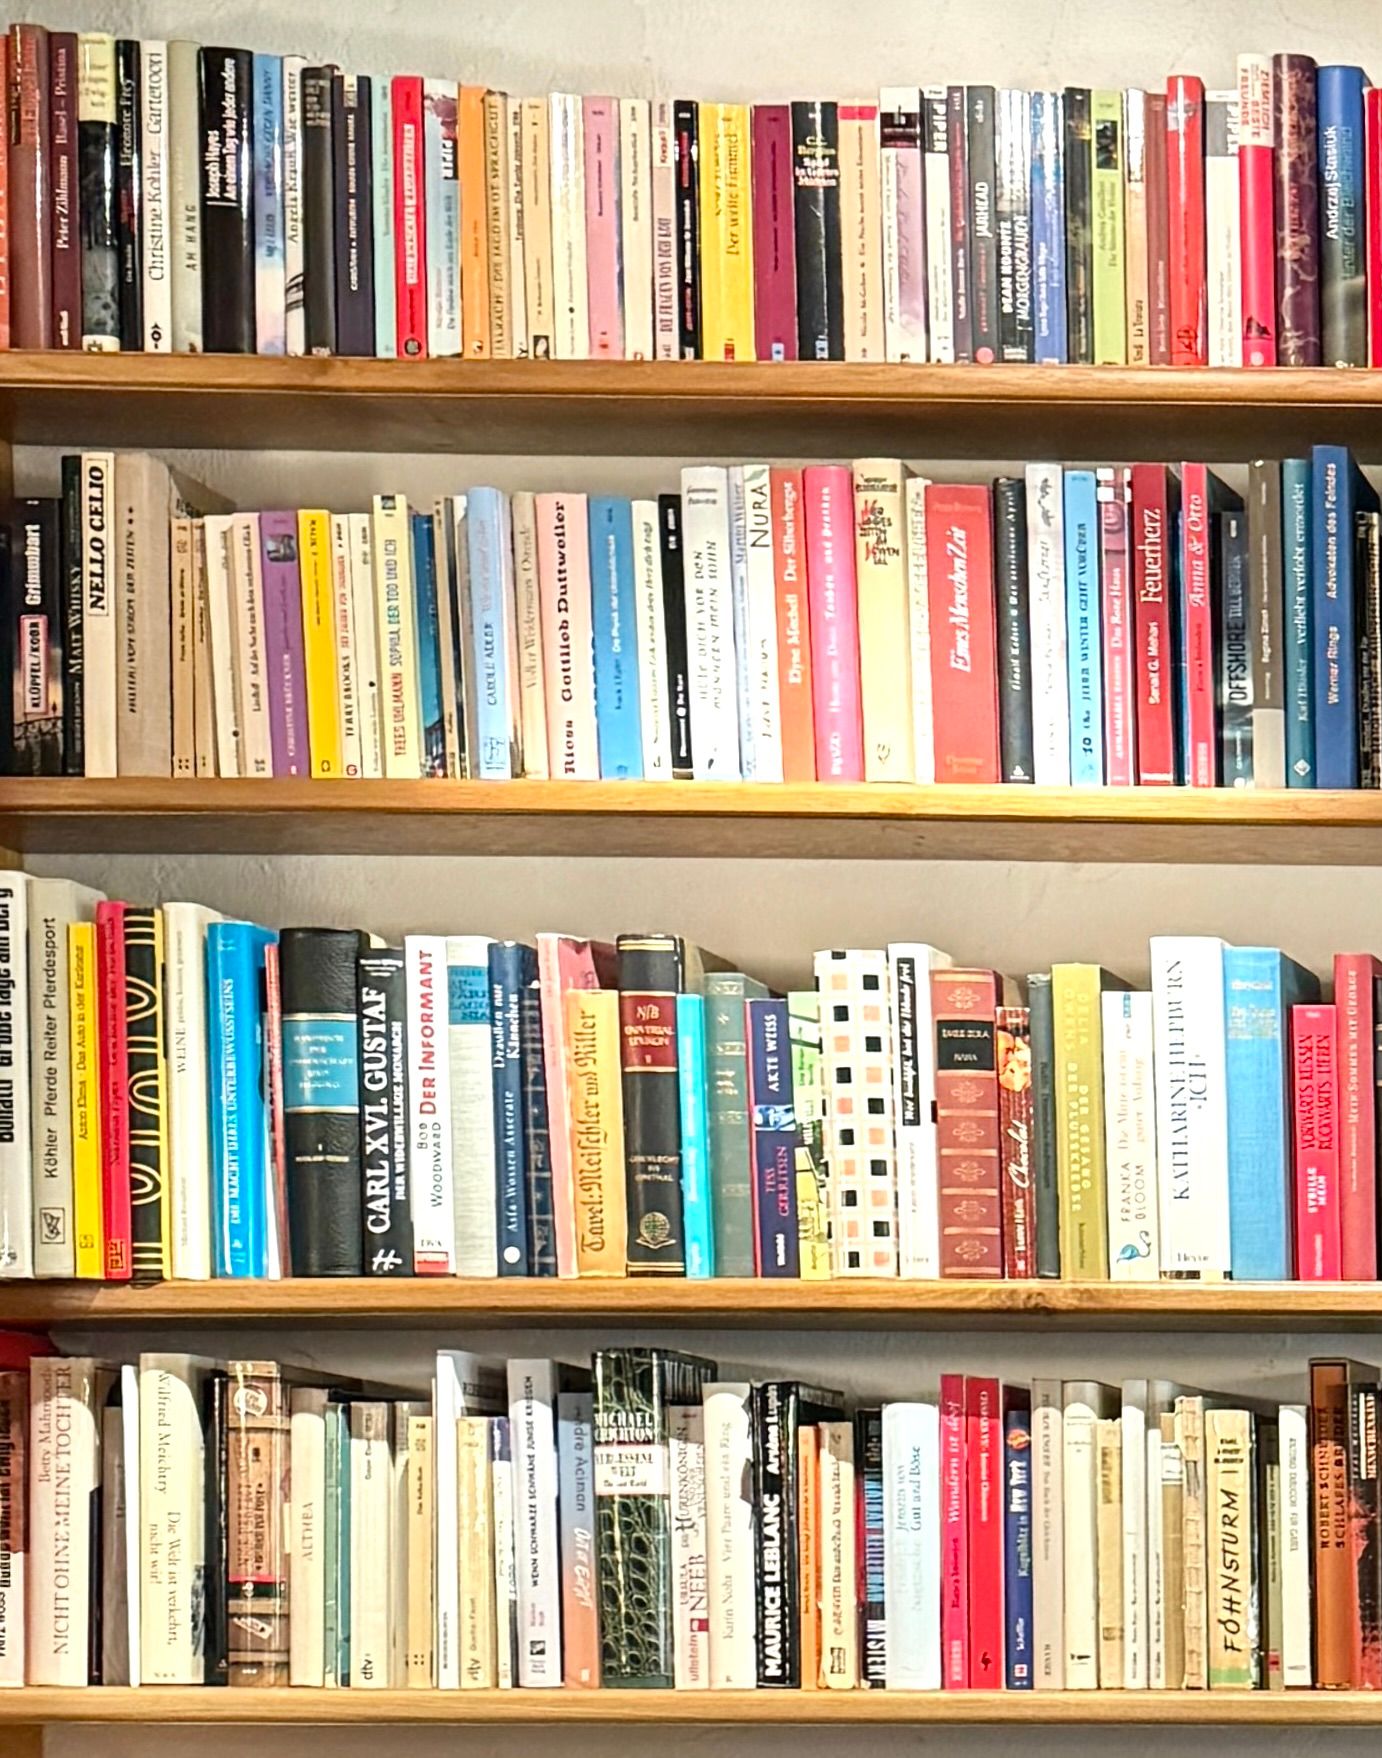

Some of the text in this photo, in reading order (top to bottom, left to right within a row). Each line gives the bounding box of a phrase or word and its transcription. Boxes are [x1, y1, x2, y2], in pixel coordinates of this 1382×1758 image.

[56, 155, 69, 248] Peter Zihlmann
[975, 182, 993, 237] JARHEAD
[1324, 126, 1341, 239] Andrzej Stasiuk
[23, 524, 41, 605] Grimmbart
[88, 466, 106, 611] NELLO CELIO
[749, 483, 771, 548] NURA
[1137, 508, 1163, 603] Feuerherz
[1292, 483, 1307, 645] verliebt verlobt ermordet
[554, 501, 574, 702] Gottlieb Duttweiler
[1325, 463, 1340, 704] Werner Rings Advokaten des Feindes
[1227, 623, 1249, 701] OFFSHORE
[42, 918, 59, 1178] Köhler Pferde Reiter Pferdesport
[174, 1027, 187, 1073] WEINE
[418, 950, 437, 1115] DER INFORMANT
[764, 1014, 780, 1092] AKTE WEISS
[1167, 960, 1190, 1200] KATHARINE HEPBURN
[362, 987, 391, 1234] CARL XVI. GUSTAF
[430, 1122, 444, 1207] WOODWARD
[53, 1366, 72, 1654] NICHT OHNE MEINE TOCHTER
[301, 1502, 315, 1561] ALTHEA
[1008, 1459, 1026, 1512] New York
[763, 1493, 782, 1676] MAURICE LEBLANC
[1217, 1489, 1242, 1652] FÖHNSTURM
[360, 1658, 374, 1680] dtv
